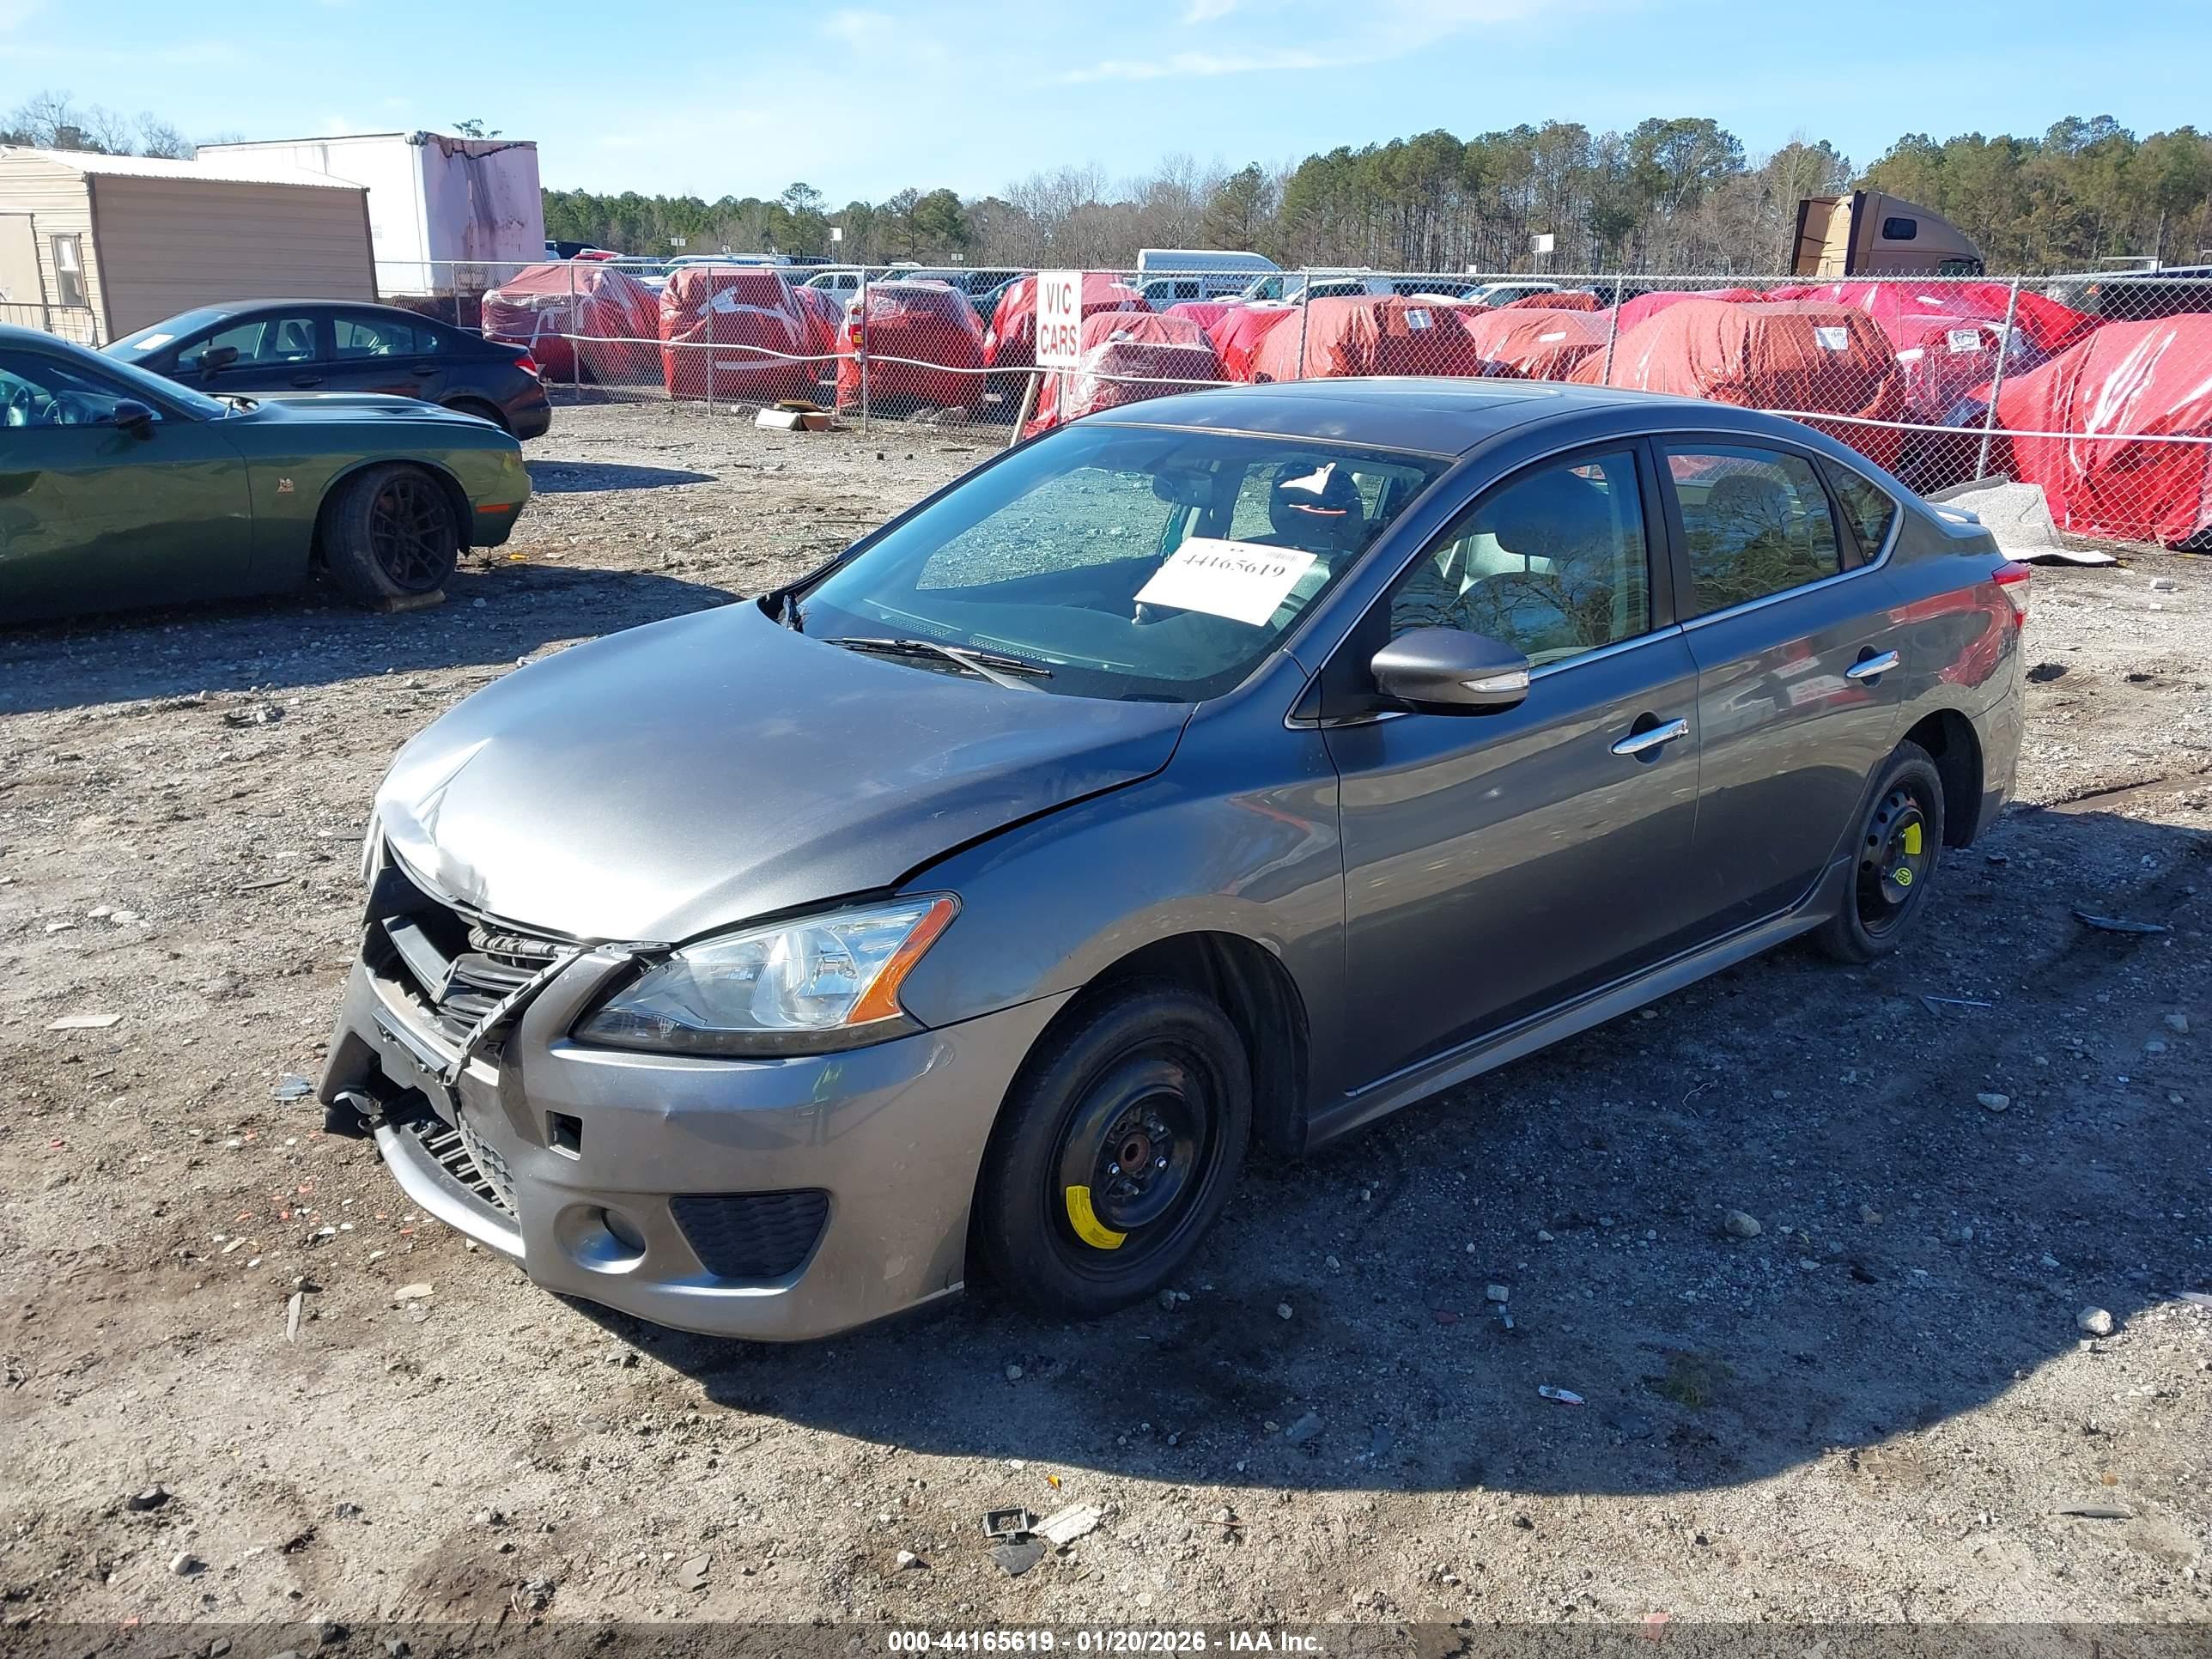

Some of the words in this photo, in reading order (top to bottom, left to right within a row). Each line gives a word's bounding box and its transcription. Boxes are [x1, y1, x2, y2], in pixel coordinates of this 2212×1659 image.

[1047, 283, 1072, 315] VIC
[1040, 324, 1077, 356] CARS
[1182, 554, 1285, 578] 44165619
